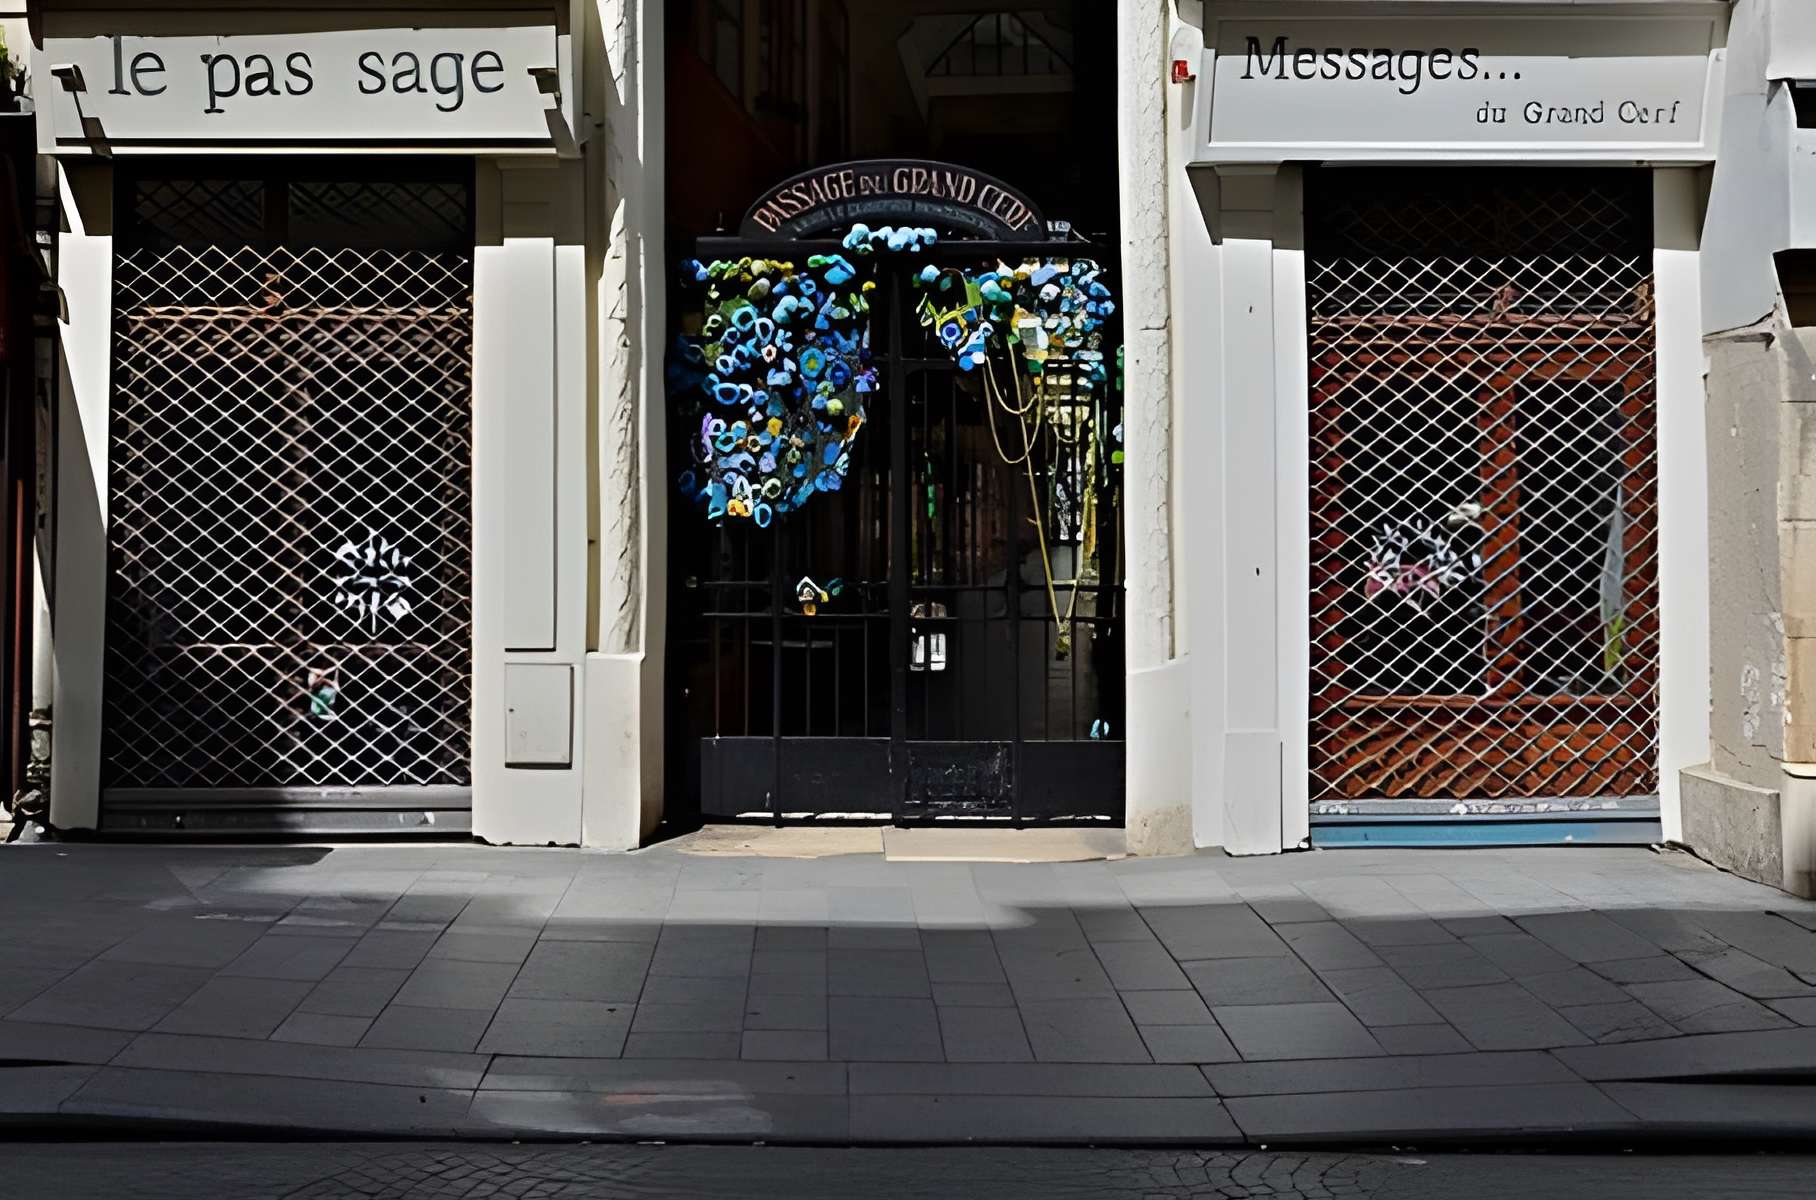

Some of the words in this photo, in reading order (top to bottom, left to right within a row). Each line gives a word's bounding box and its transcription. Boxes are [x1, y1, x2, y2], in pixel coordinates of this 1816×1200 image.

[107, 34, 168, 96] le
[200, 50, 314, 114] pas
[357, 48, 505, 113] sage
[1239, 35, 1523, 95] Messages...
[1475, 100, 1507, 124] du
[1523, 100, 1605, 125] Grand
[752, 169, 854, 233] PASSAGE
